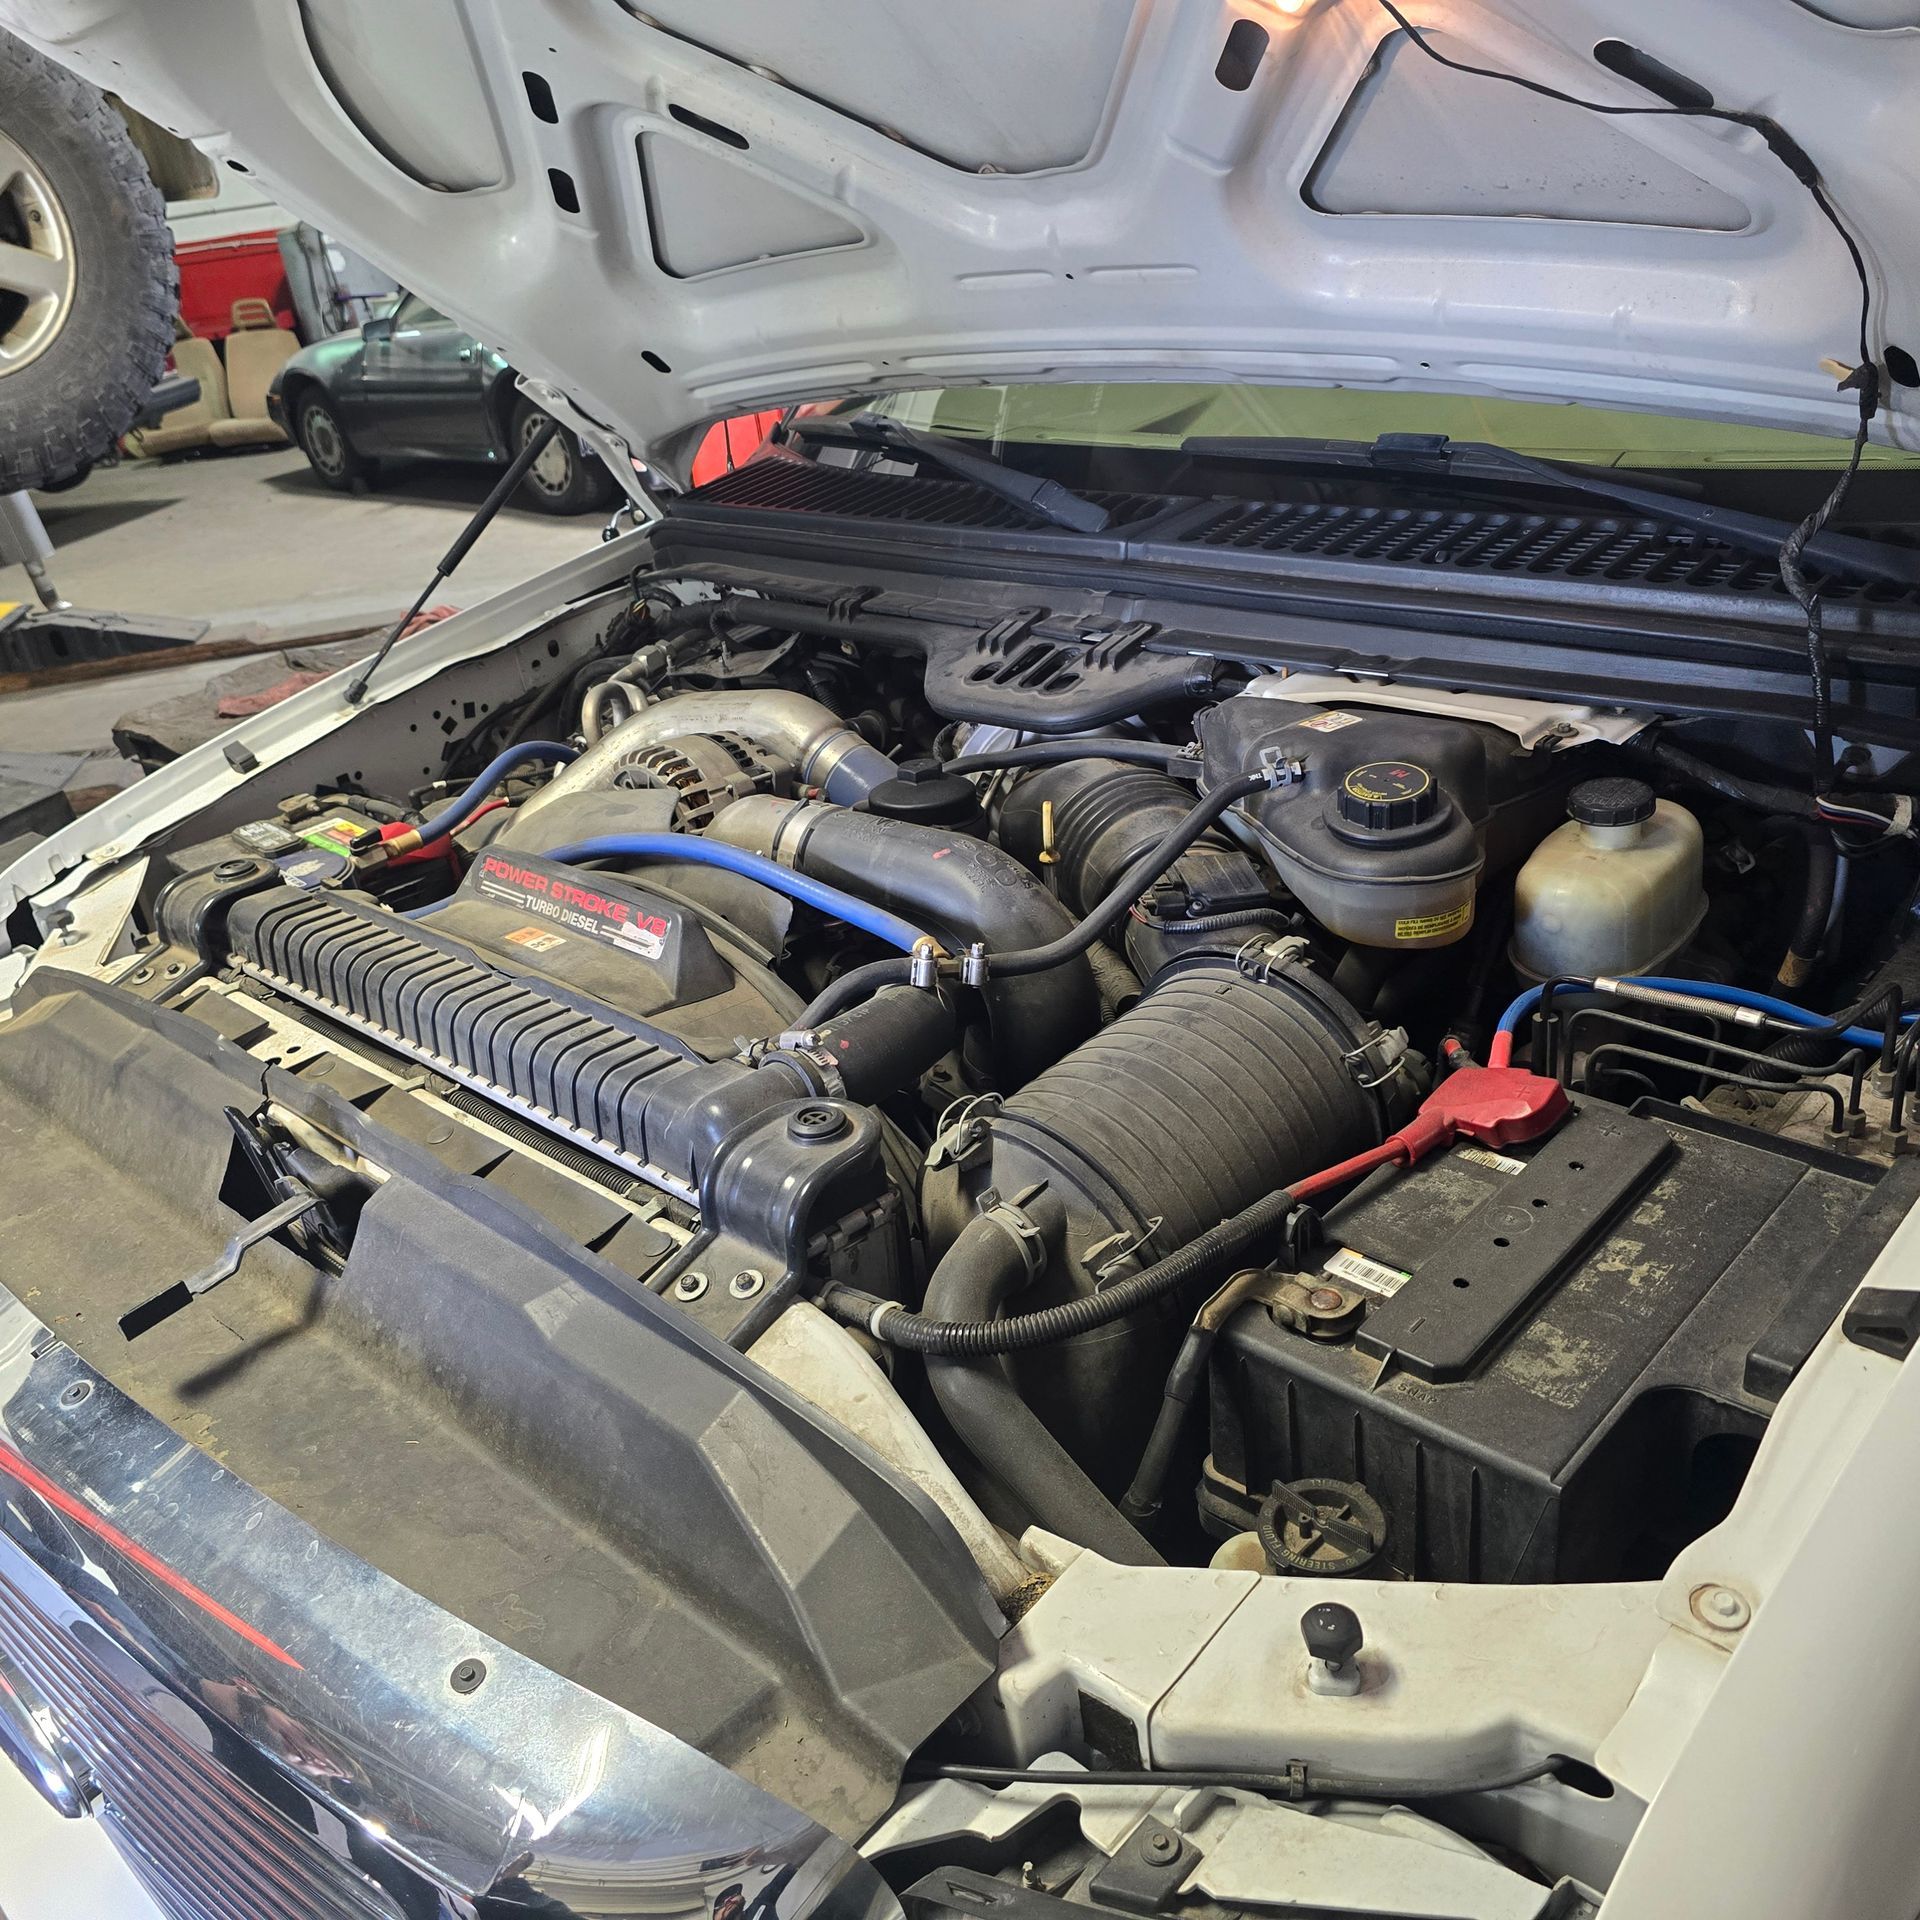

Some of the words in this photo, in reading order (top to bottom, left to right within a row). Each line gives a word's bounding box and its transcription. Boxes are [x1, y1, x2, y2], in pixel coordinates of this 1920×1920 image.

[483, 858, 548, 892] POWER
[551, 881, 630, 923] STROKE
[636, 911, 668, 937] V8
[525, 895, 561, 919] TURBO
[561, 909, 599, 934] DIESEL
[1397, 1383, 1438, 1404] SNAP
[1262, 1525, 1282, 1548] FLUID
[1281, 1549, 1336, 1570] STEERING
